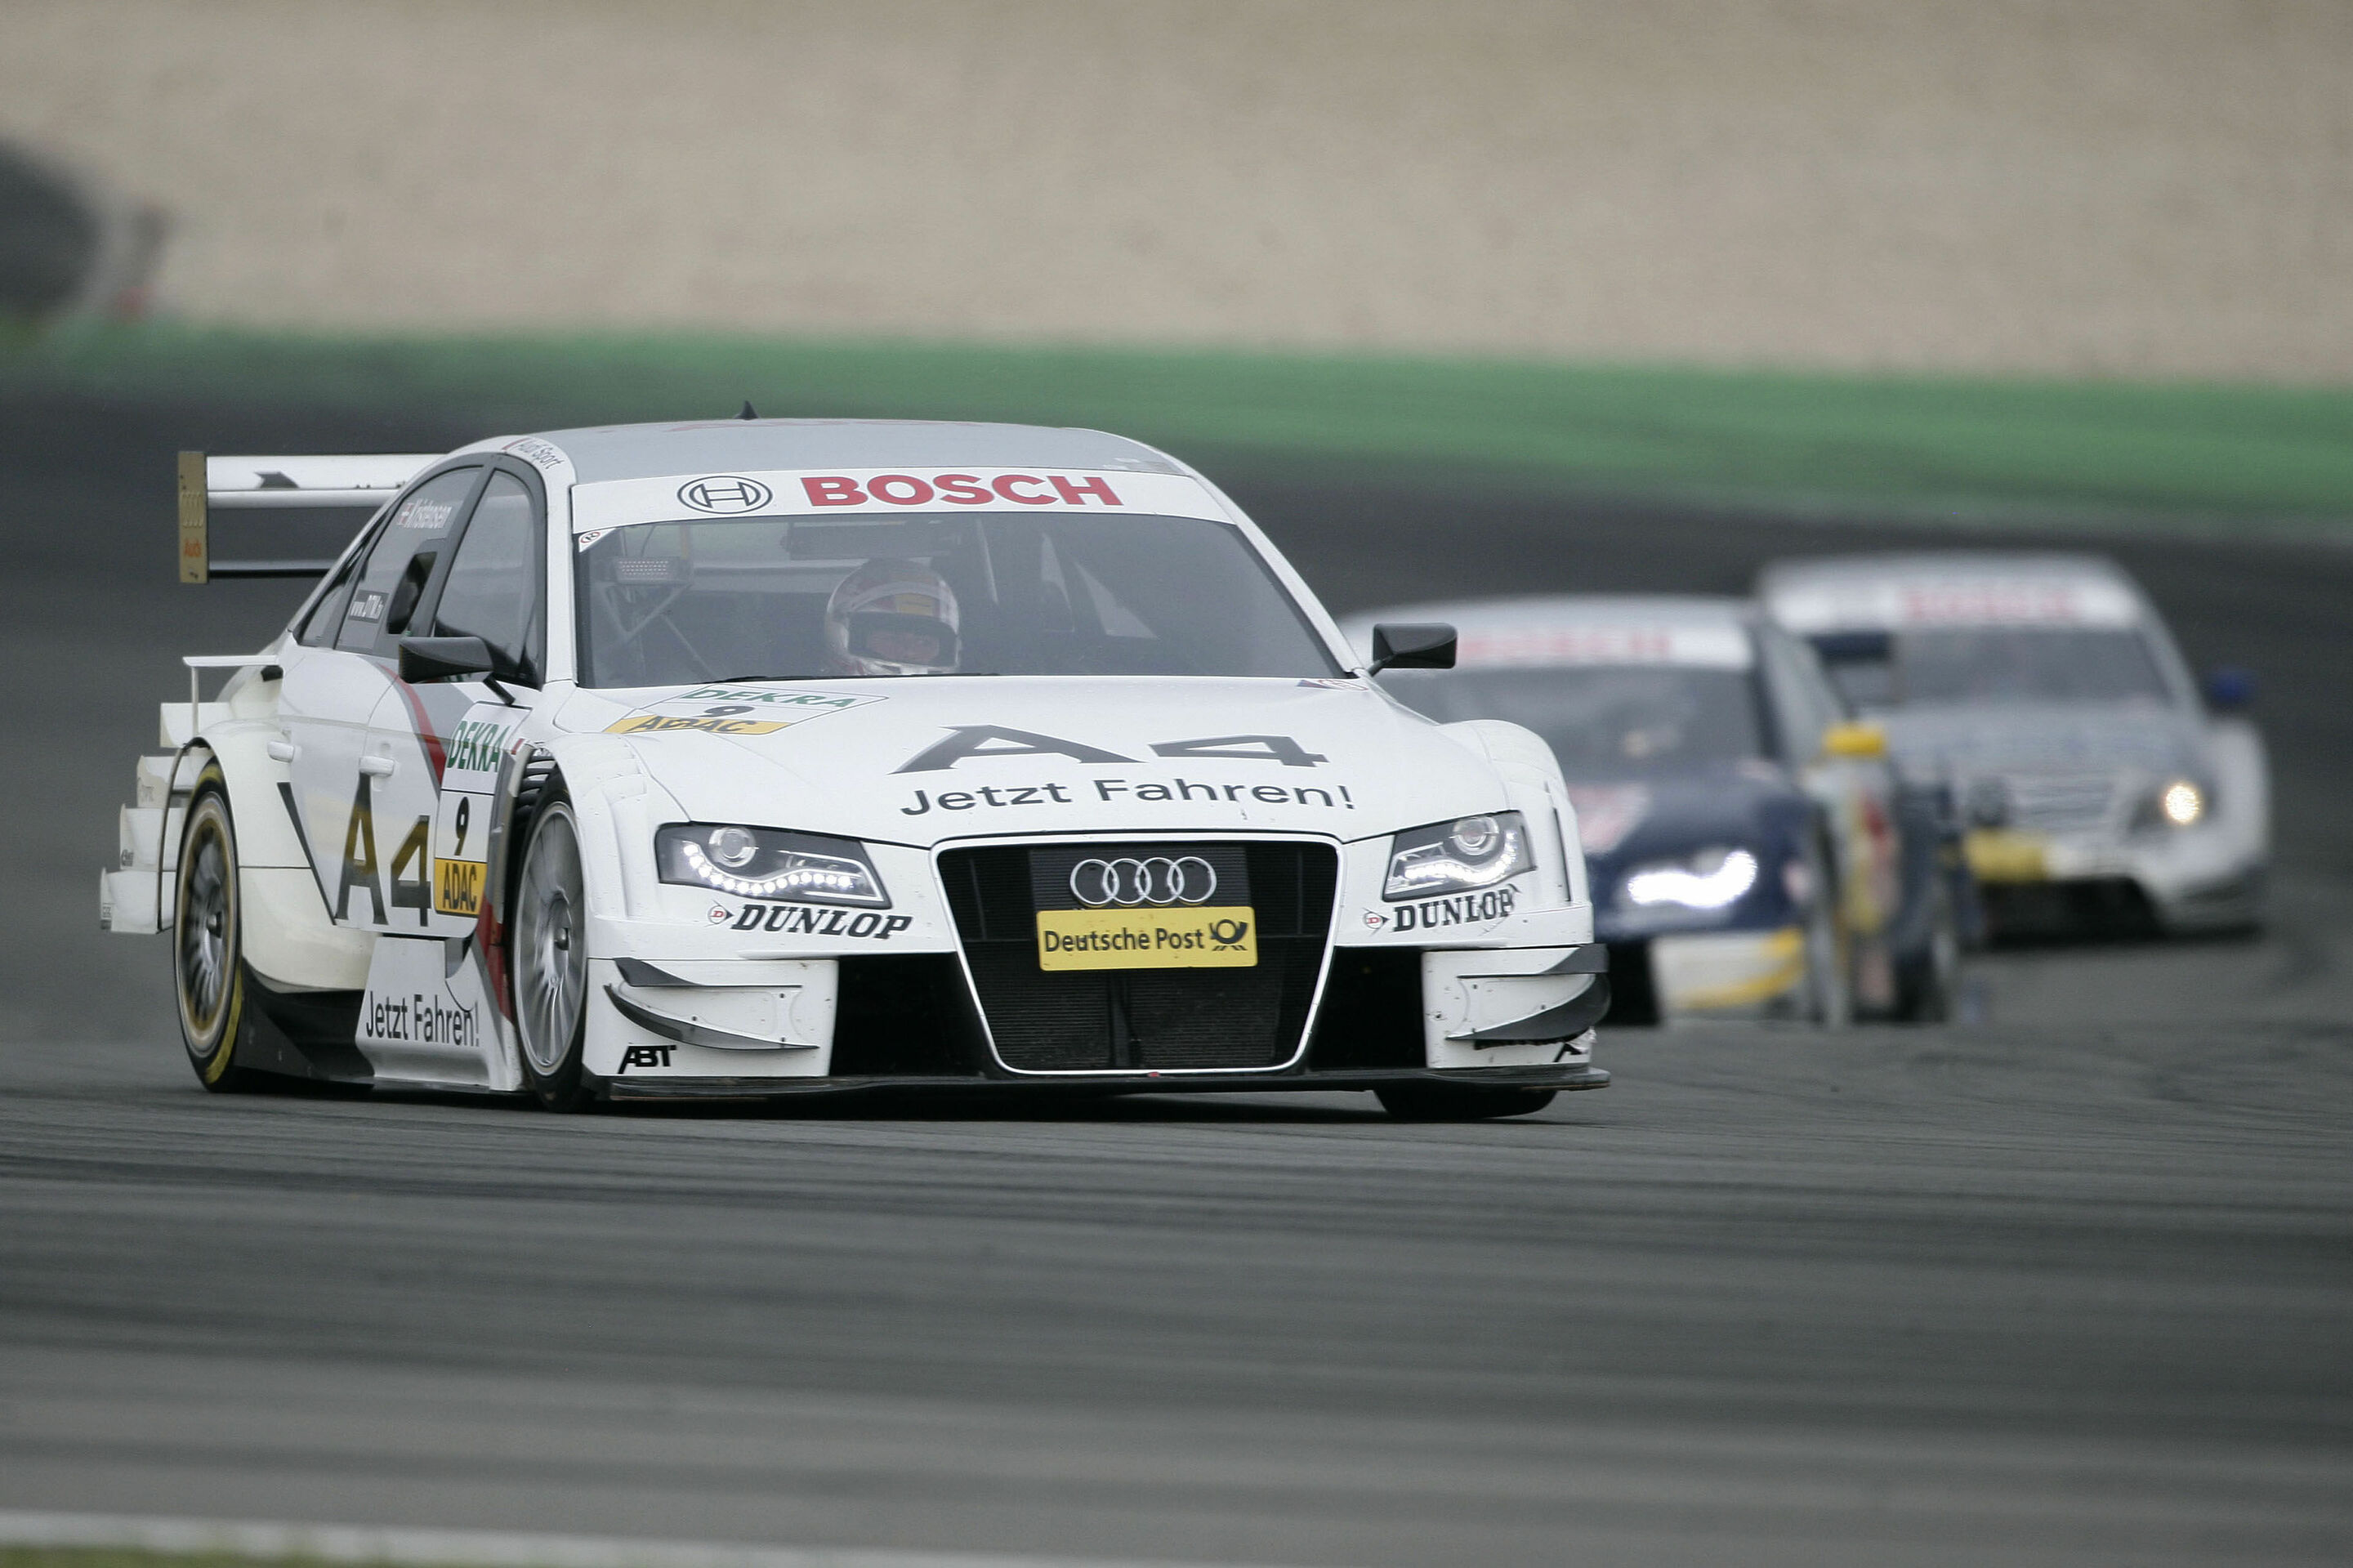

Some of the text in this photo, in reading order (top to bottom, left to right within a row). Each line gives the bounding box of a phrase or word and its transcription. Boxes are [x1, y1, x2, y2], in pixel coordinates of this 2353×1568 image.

[800, 475, 1123, 507] BOSCH
[681, 689, 857, 708] DEKRA
[699, 705, 755, 717] 9
[627, 715, 755, 732] ADAC
[447, 720, 511, 773] DEKRA
[887, 724, 1330, 775] A4
[900, 778, 1355, 816] Jetzt Fahren!
[454, 796, 470, 856] 9
[334, 772, 432, 927] A4
[442, 862, 477, 912] ADAC
[731, 903, 912, 940] DUNLOP
[1392, 888, 1515, 932] DUNLOP
[1043, 927, 1205, 952] Deutsche Post
[366, 991, 480, 1048] Jetzt Fahren!
[618, 1044, 676, 1074] ABT
